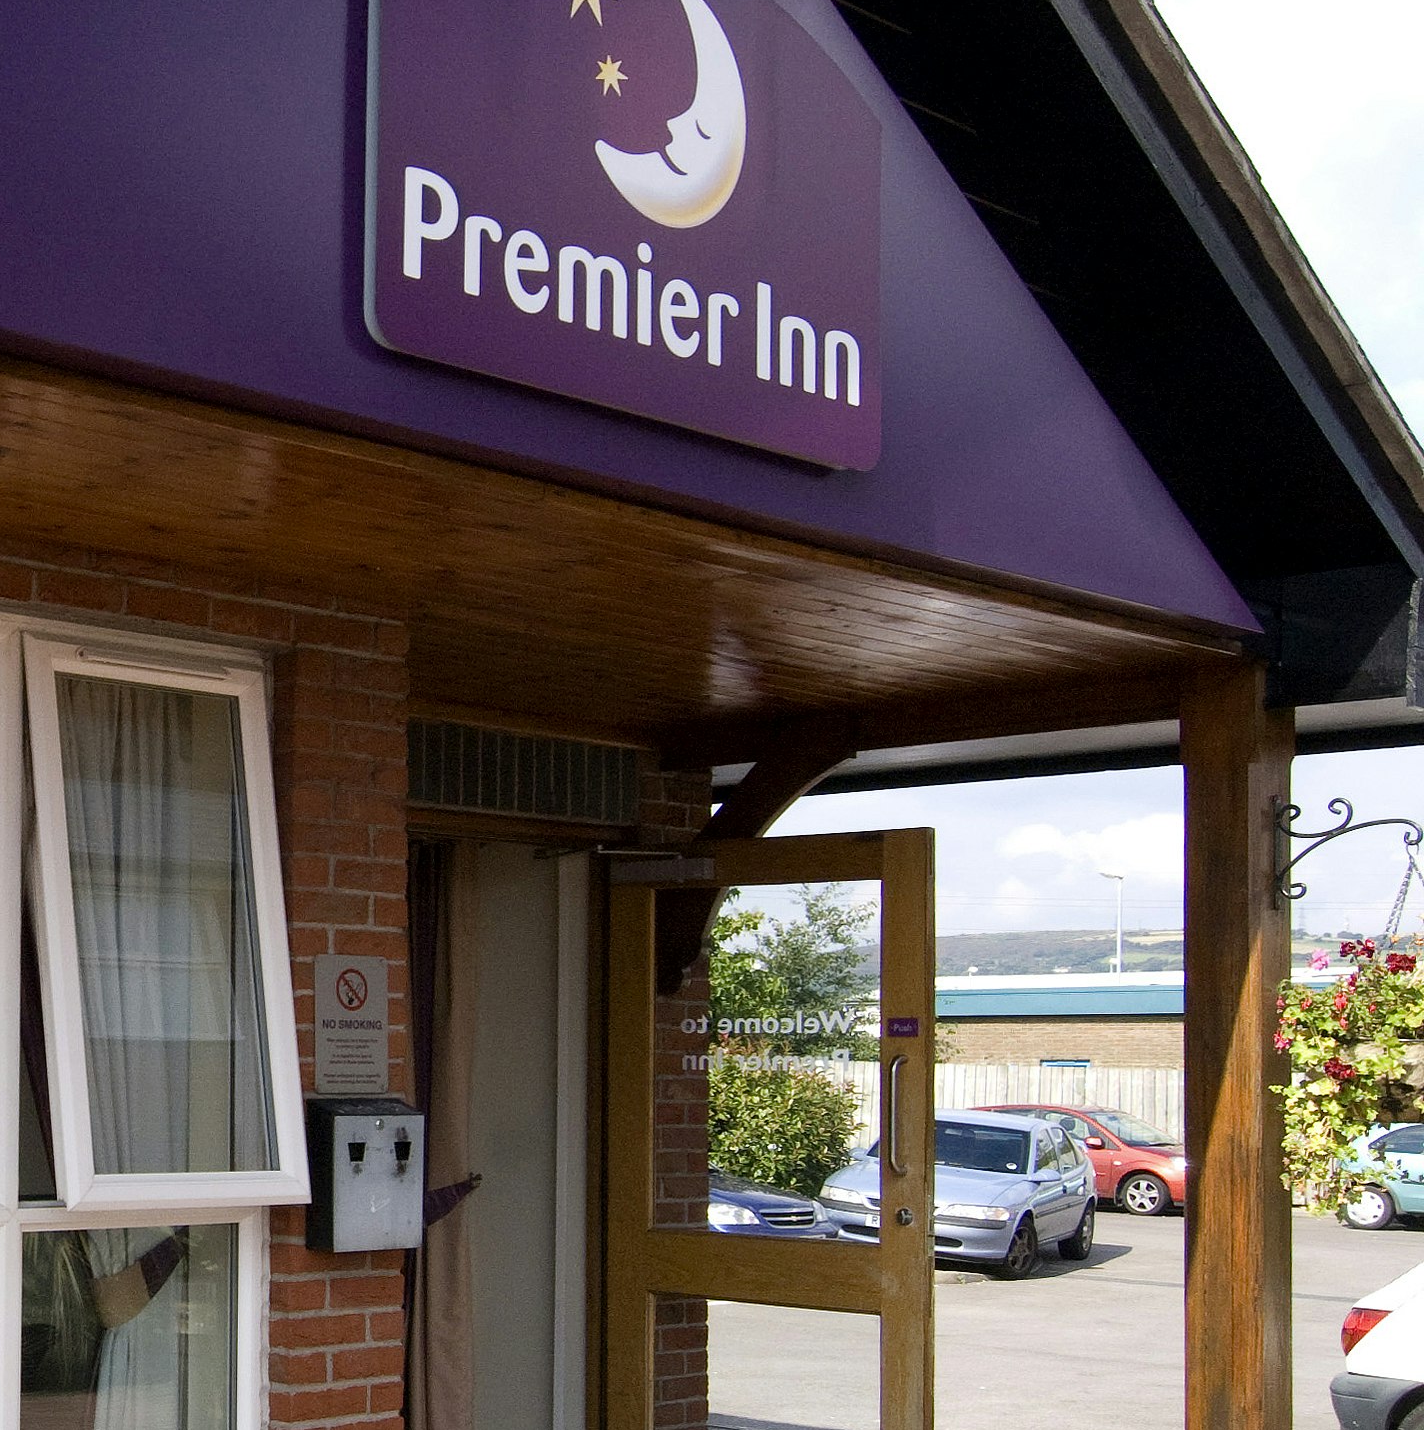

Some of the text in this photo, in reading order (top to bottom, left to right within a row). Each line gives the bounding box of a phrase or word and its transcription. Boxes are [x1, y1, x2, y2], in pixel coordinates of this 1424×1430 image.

[403, 166, 861, 407] Premier Inn
[322, 1019, 383, 1030] NO SMOKING
[893, 1023, 913, 1032] Push
